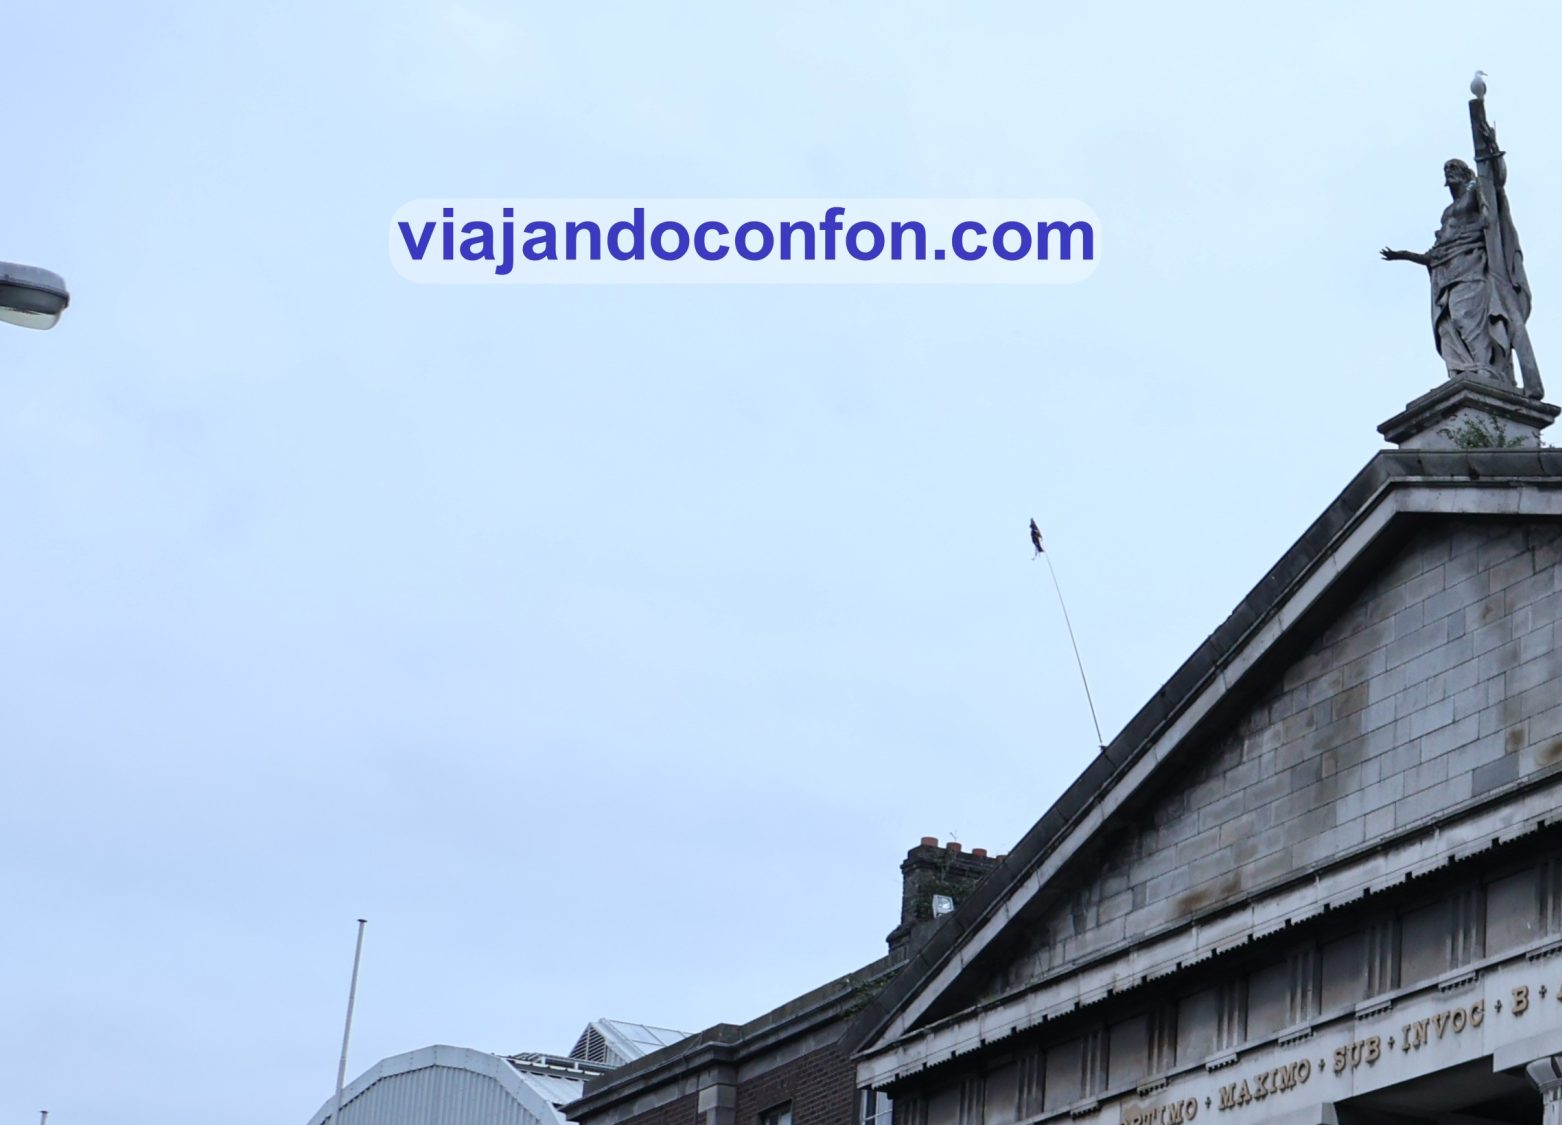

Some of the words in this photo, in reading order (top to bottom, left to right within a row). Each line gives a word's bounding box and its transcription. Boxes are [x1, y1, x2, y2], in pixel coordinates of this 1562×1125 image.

[1218, 1057, 1311, 1111] MAXIMO
[1333, 1034, 1381, 1072] SUB
[1401, 999, 1484, 1053] INVOC
[1512, 985, 1529, 1016] B
